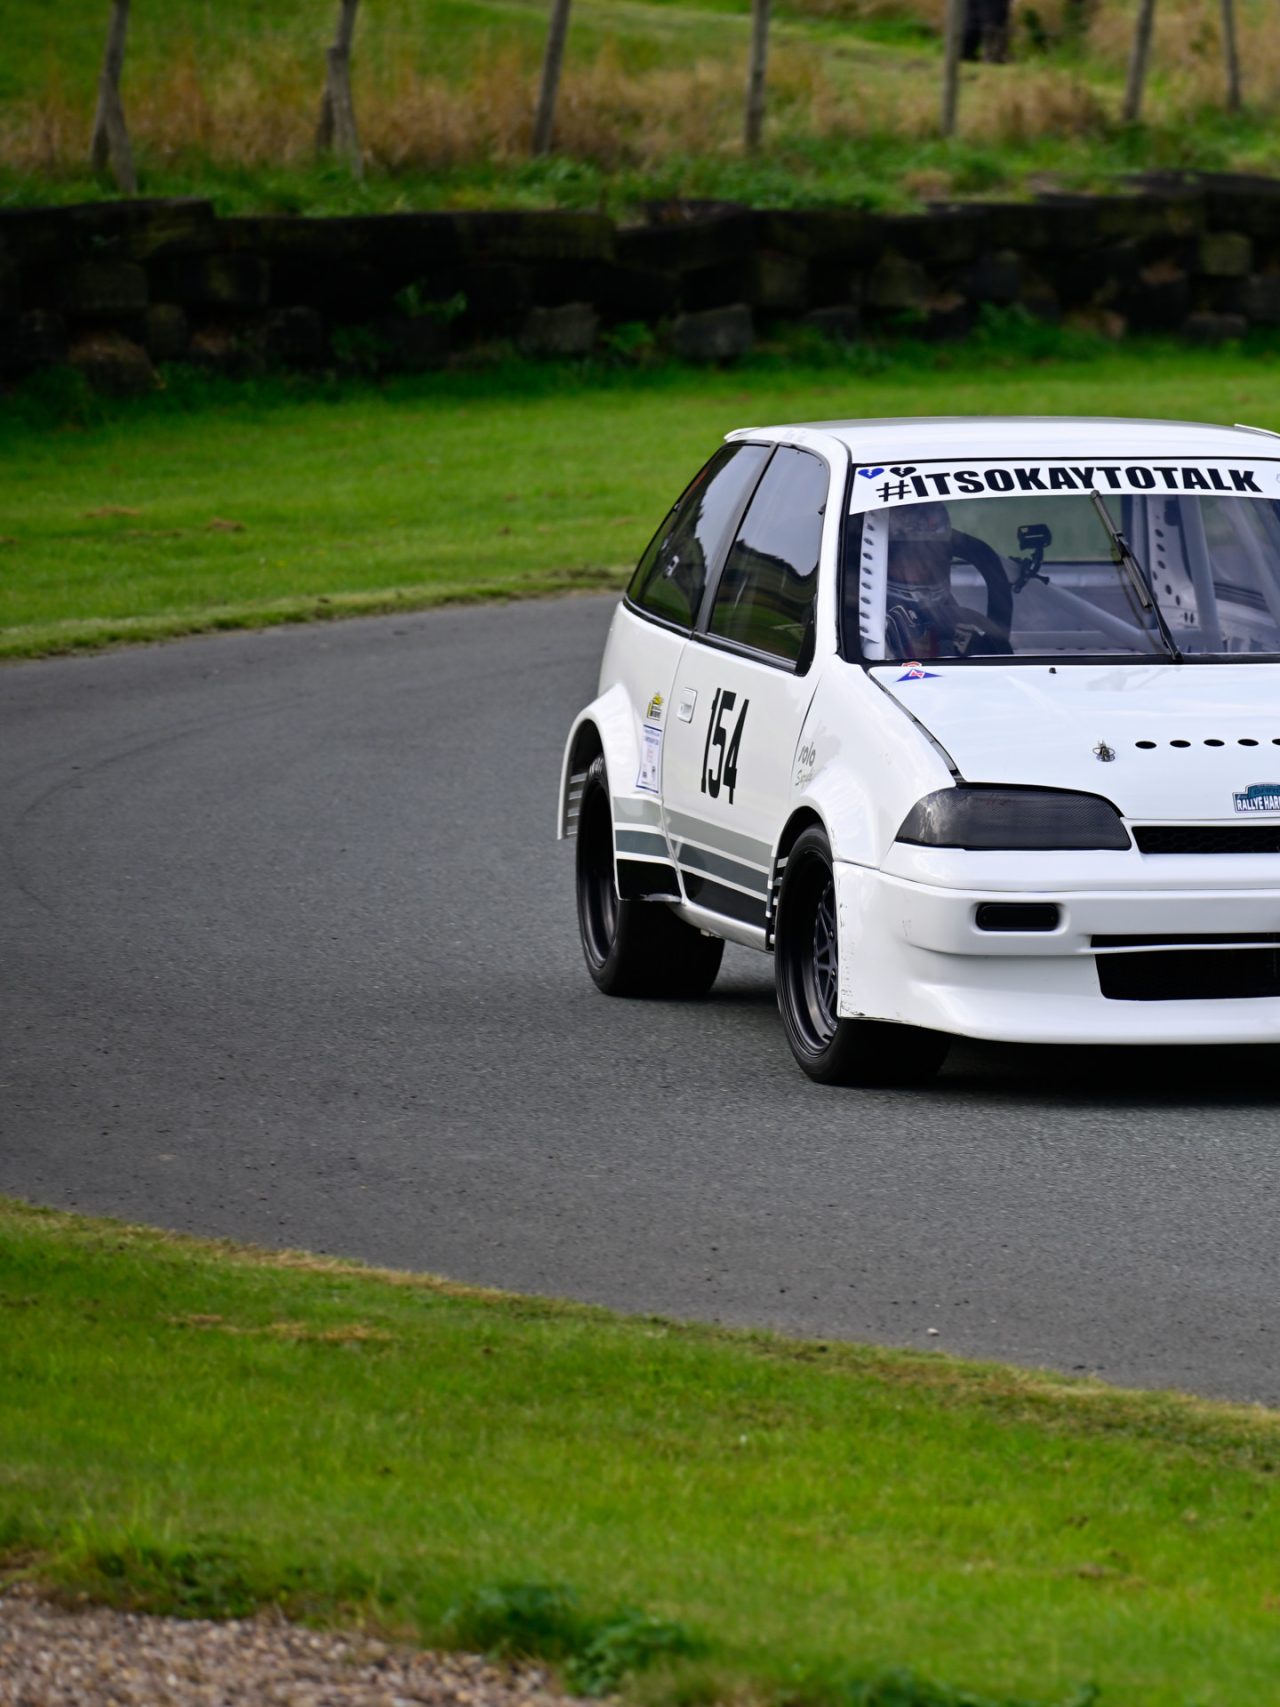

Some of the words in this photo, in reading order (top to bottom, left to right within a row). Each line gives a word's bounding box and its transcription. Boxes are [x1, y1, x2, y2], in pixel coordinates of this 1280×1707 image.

[876, 466, 1263, 502] #ITSOKAYTOTALK
[701, 688, 750, 805] 154
[1237, 796, 1264, 811] RALLYE
